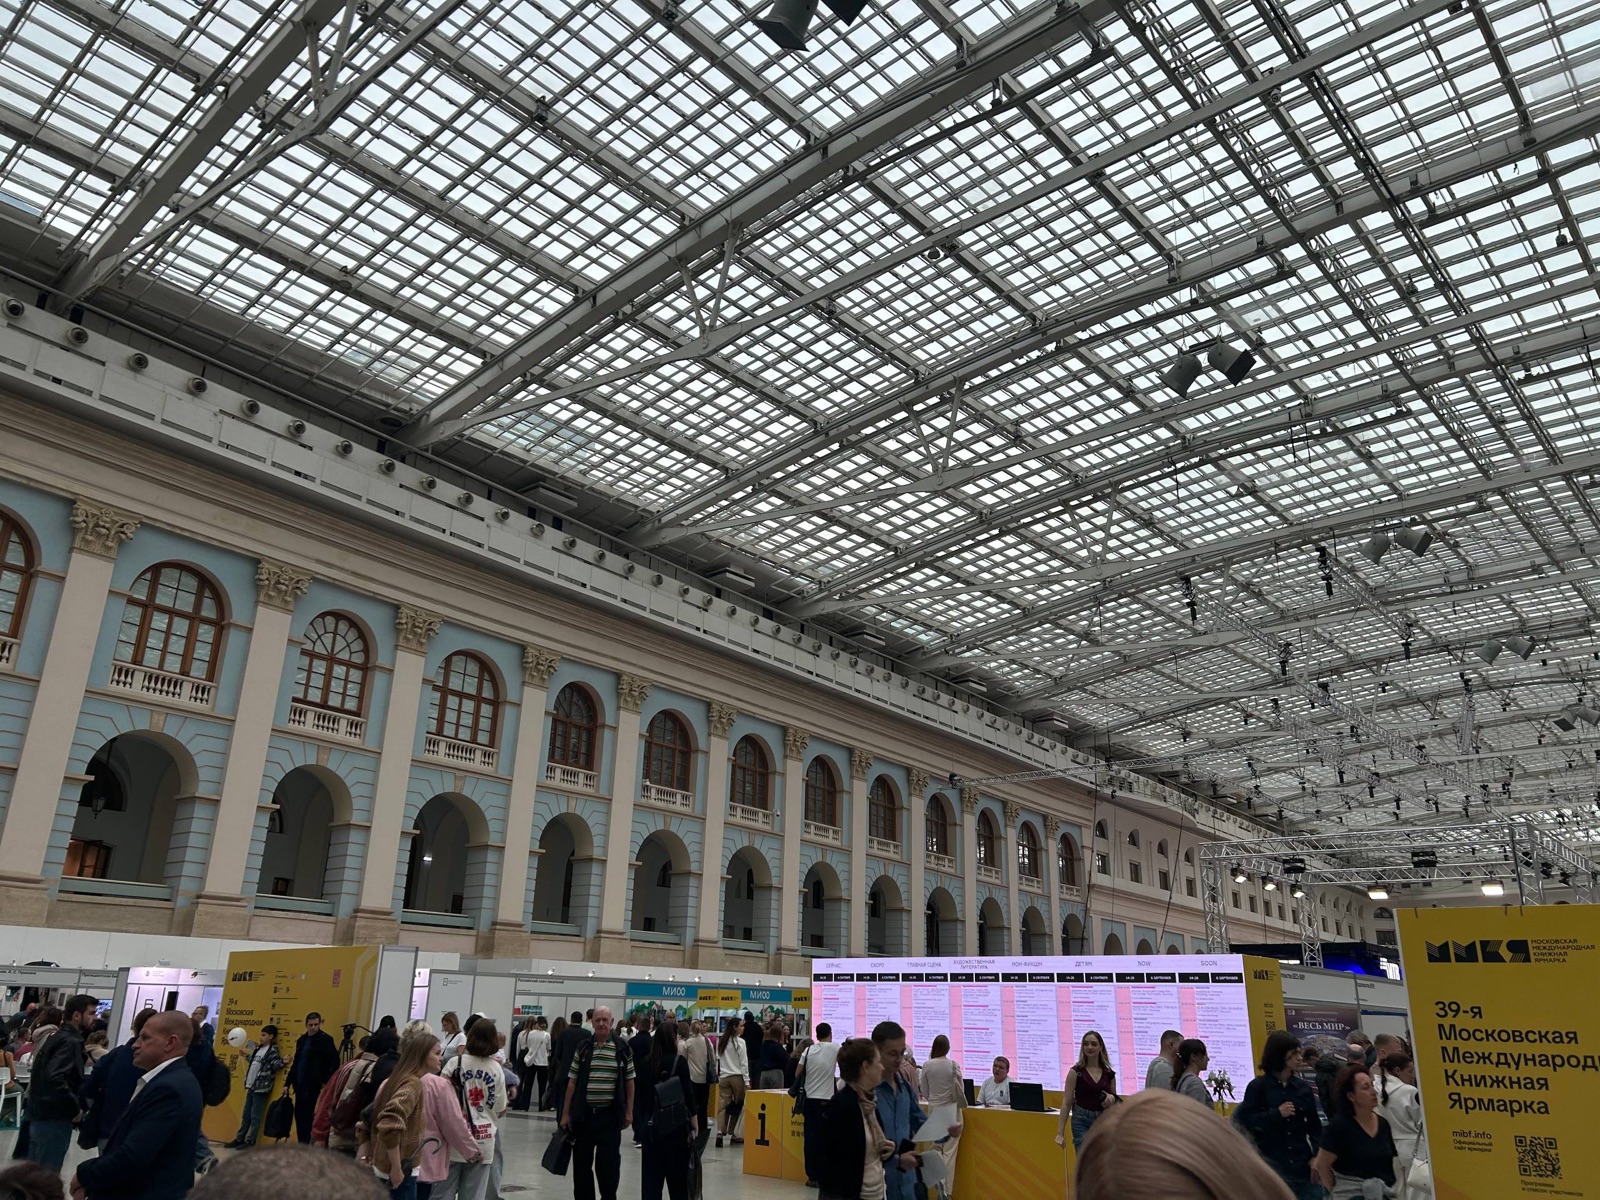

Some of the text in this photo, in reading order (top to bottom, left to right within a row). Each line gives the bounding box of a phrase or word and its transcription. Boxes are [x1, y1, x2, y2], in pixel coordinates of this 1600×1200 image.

[226, 1007, 254, 1016] Московская
[1434, 1000, 1483, 1019] 39-я
[224, 1017, 263, 1027] Международная
[1292, 1021, 1351, 1031] «ВЕСЬ МИР»
[1437, 1023, 1579, 1045] Московская
[1440, 1046, 1600, 1073] Международ
[1443, 1068, 1550, 1091] Книжная
[1447, 1092, 1551, 1118] Ярмарка
[1452, 1129, 1493, 1140] mibf.info
[1453, 1139, 1493, 1148] Официальный
